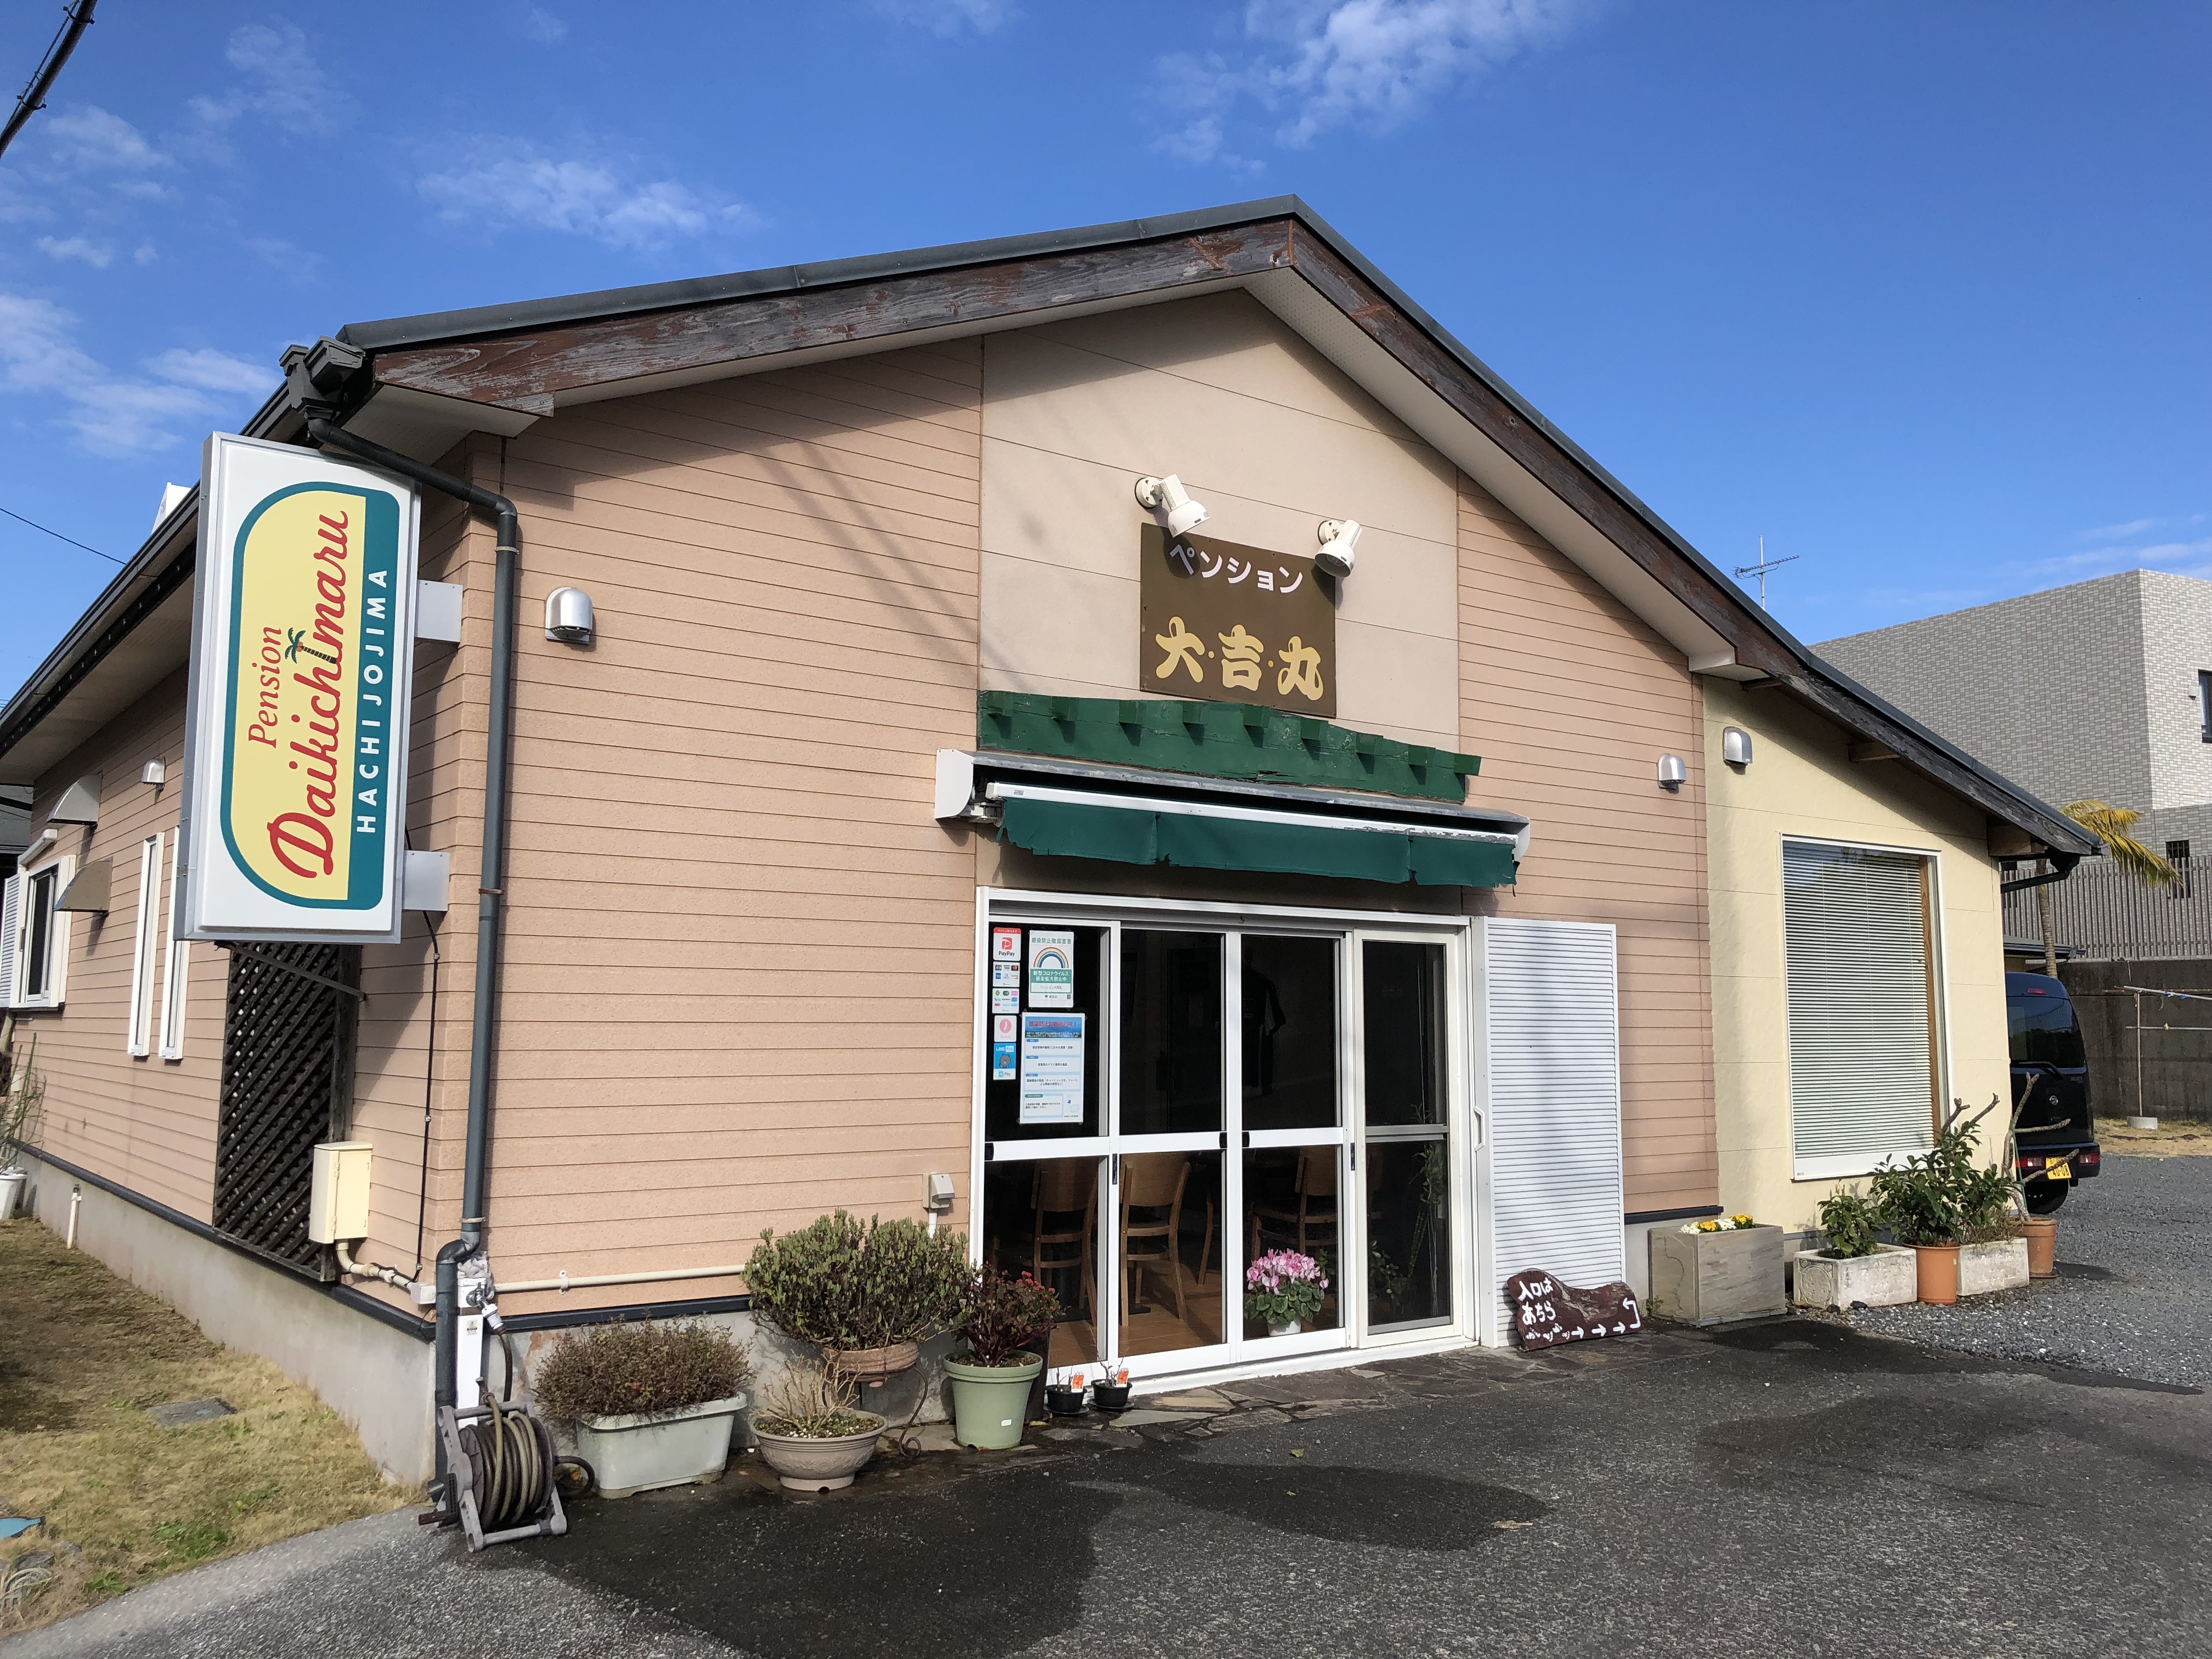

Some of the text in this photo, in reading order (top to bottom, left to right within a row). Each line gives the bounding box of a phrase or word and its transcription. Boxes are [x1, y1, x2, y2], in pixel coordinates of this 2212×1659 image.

[1169, 544, 1303, 594] ペンション
[249, 625, 282, 749] Pension
[267, 510, 349, 878] Daikichimaru
[357, 569, 388, 833] HACHIJOJIMA
[1517, 1277, 1554, 1301] 入口は
[1522, 1300, 1556, 1325] あちら
